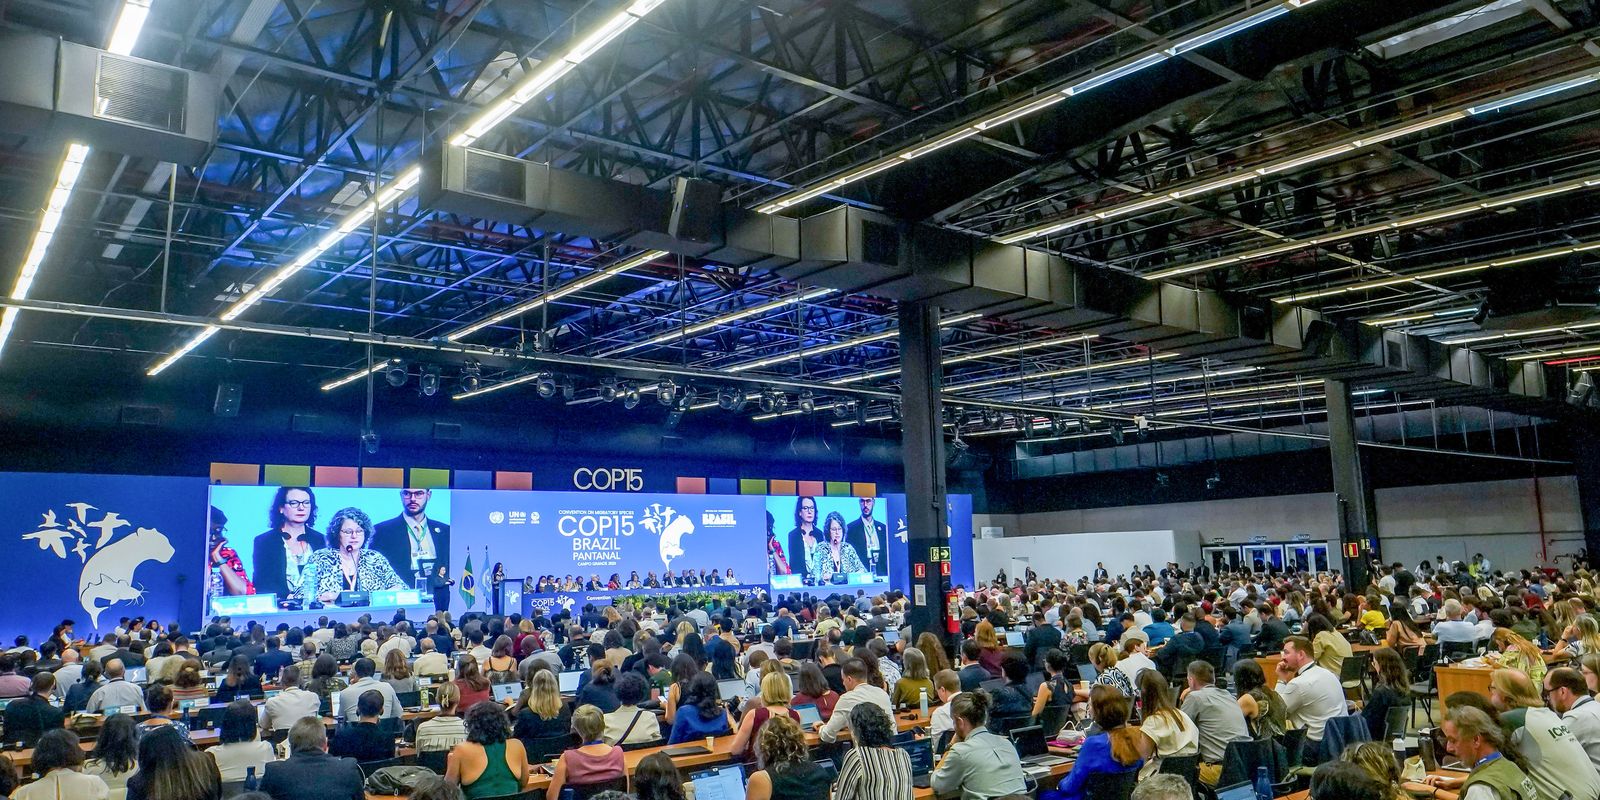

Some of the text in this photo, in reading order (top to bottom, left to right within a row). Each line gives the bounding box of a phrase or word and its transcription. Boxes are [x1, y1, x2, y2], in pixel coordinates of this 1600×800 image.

[573, 467, 644, 491] COP15
[557, 515, 635, 537] COP15
[572, 537, 621, 551] BRAZIL
[572, 551, 621, 561] PANTANAL
[531, 599, 555, 608] COP15
